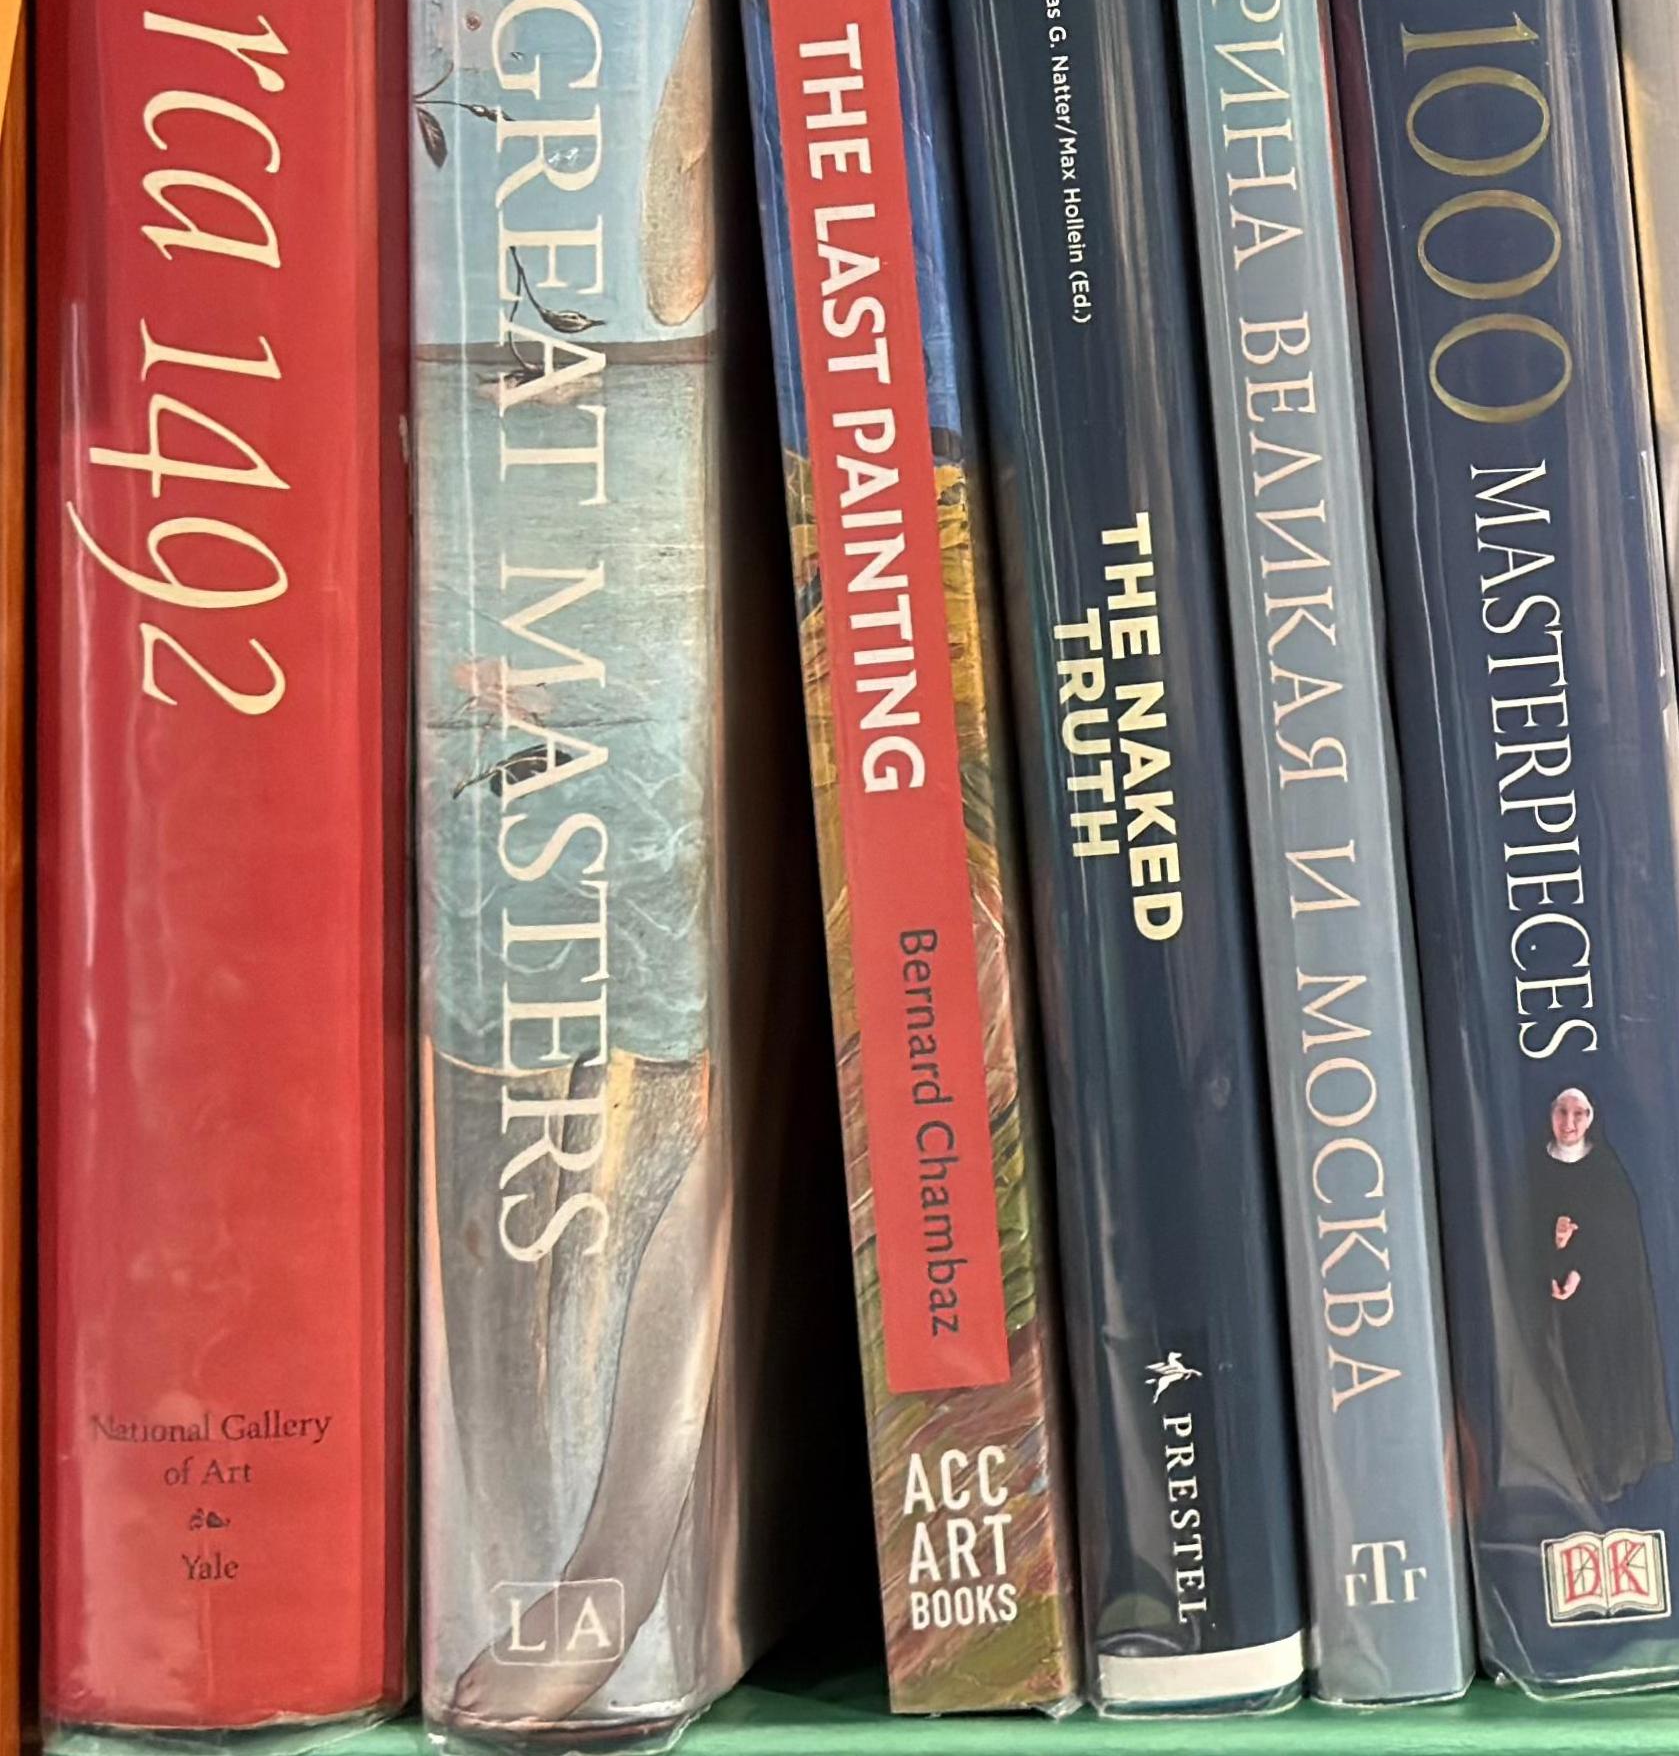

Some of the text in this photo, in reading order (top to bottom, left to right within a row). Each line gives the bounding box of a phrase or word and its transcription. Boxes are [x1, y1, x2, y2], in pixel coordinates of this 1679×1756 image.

[1047, 25, 1067, 49] G.
[1063, 186, 1087, 264] Hollein
[1068, 269, 1094, 325] (Ed.)
[798, 22, 926, 795] THE LAST PAINTING
[65, 314, 292, 717] 1492
[1239, 310, 1350, 791] ВЕЛИКАЯ
[1399, 10, 1601, 1062] 1000 MASTERPIECES
[1053, 606, 1120, 858] TRUTH
[1101, 511, 1184, 941] THE NAKED
[496, 562, 613, 1267] MASTERS
[1288, 839, 1361, 920] И
[898, 928, 968, 1339] Bernard Chambaz
[1296, 966, 1404, 1413] МОСКВА
[90, 1410, 332, 1446] National Gallery
[163, 1455, 253, 1487] of Art
[902, 1445, 1011, 1516] ACC
[907, 1513, 1013, 1585] ART
[1162, 1412, 1208, 1624] PRESTEL
[182, 1552, 239, 1581] Yale
[910, 1582, 1019, 1632] BOOKS
[1561, 1537, 1650, 1605] DK
